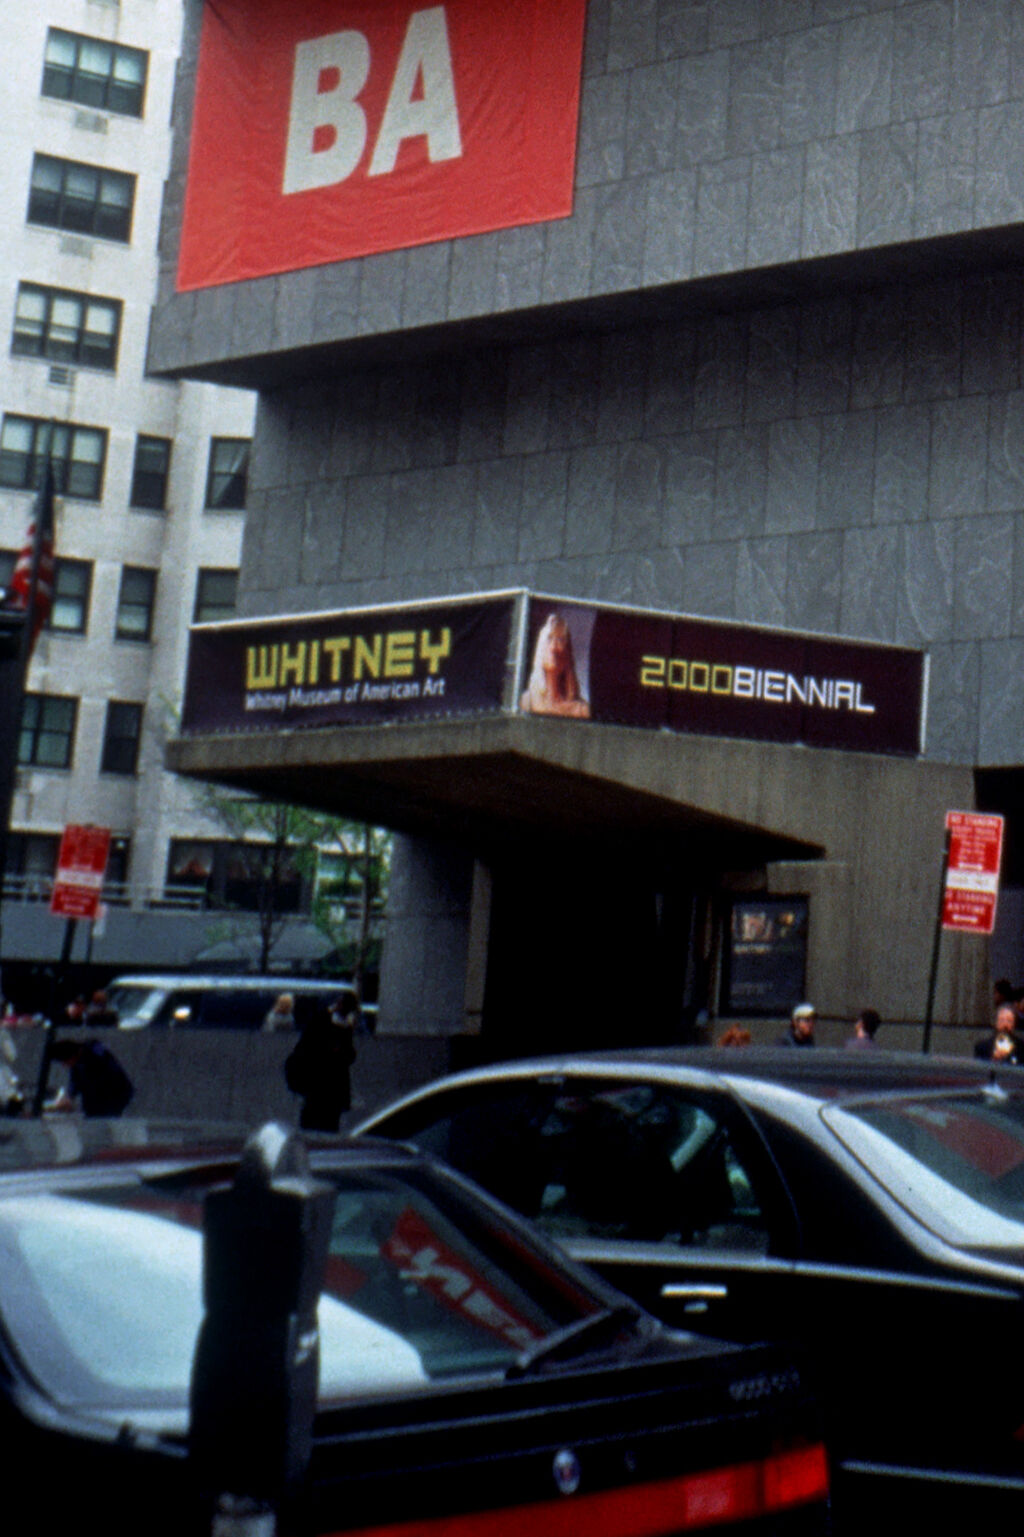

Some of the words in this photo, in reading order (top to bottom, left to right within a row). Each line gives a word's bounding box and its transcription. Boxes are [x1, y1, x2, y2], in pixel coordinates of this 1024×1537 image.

[282, 5, 462, 195] BA
[246, 627, 450, 690] WHITNEY
[289, 686, 342, 707] Museum
[344, 682, 360, 702] of
[361, 680, 420, 701] American
[423, 676, 445, 696] Art
